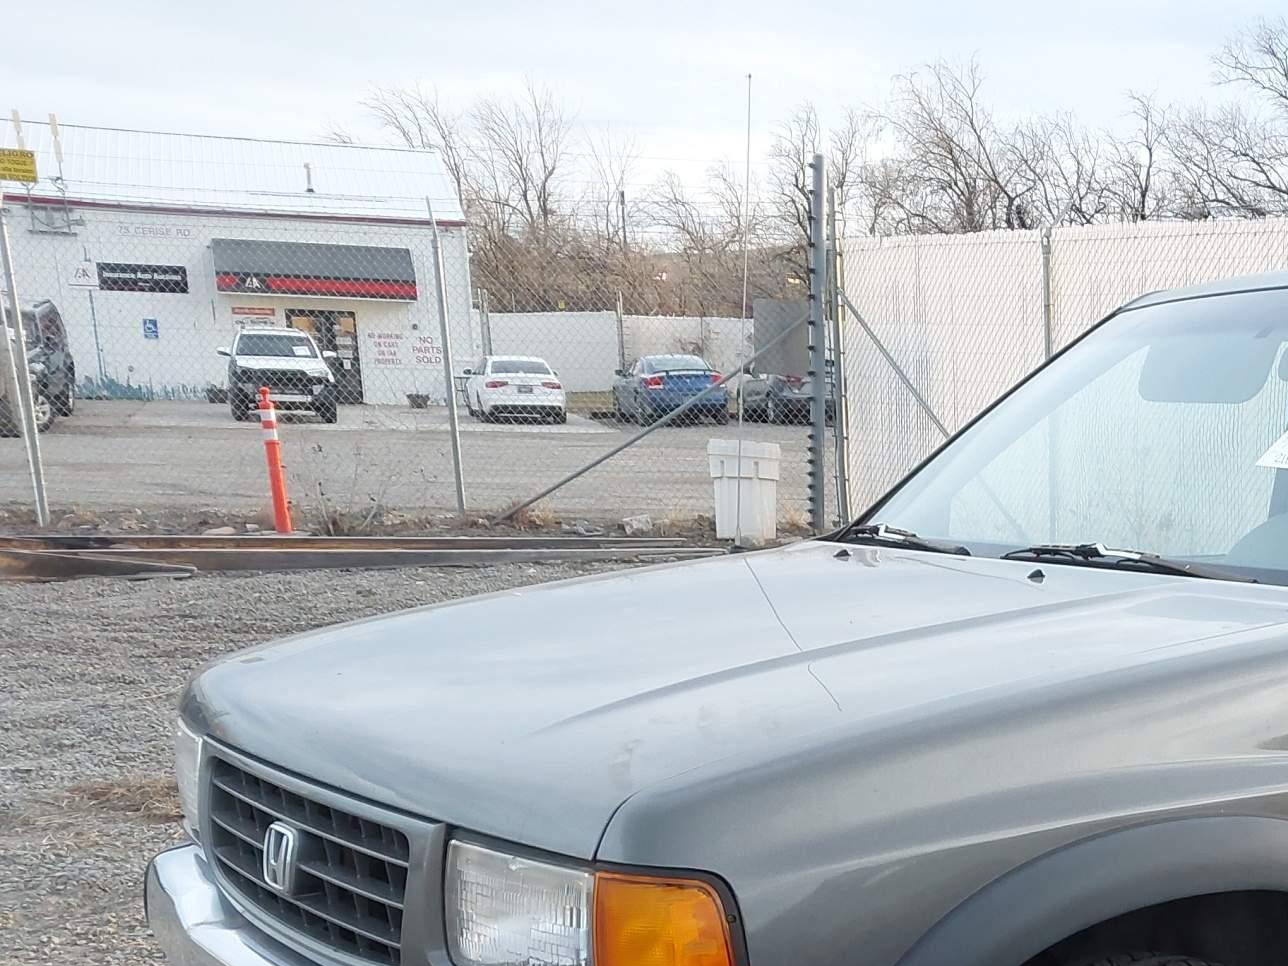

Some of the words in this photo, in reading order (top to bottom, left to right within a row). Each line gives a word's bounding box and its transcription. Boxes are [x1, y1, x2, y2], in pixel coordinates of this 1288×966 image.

[176, 228, 191, 237] RD
[418, 336, 433, 344] NO
[412, 346, 442, 354] PARTS
[415, 355, 442, 364] SOLD
